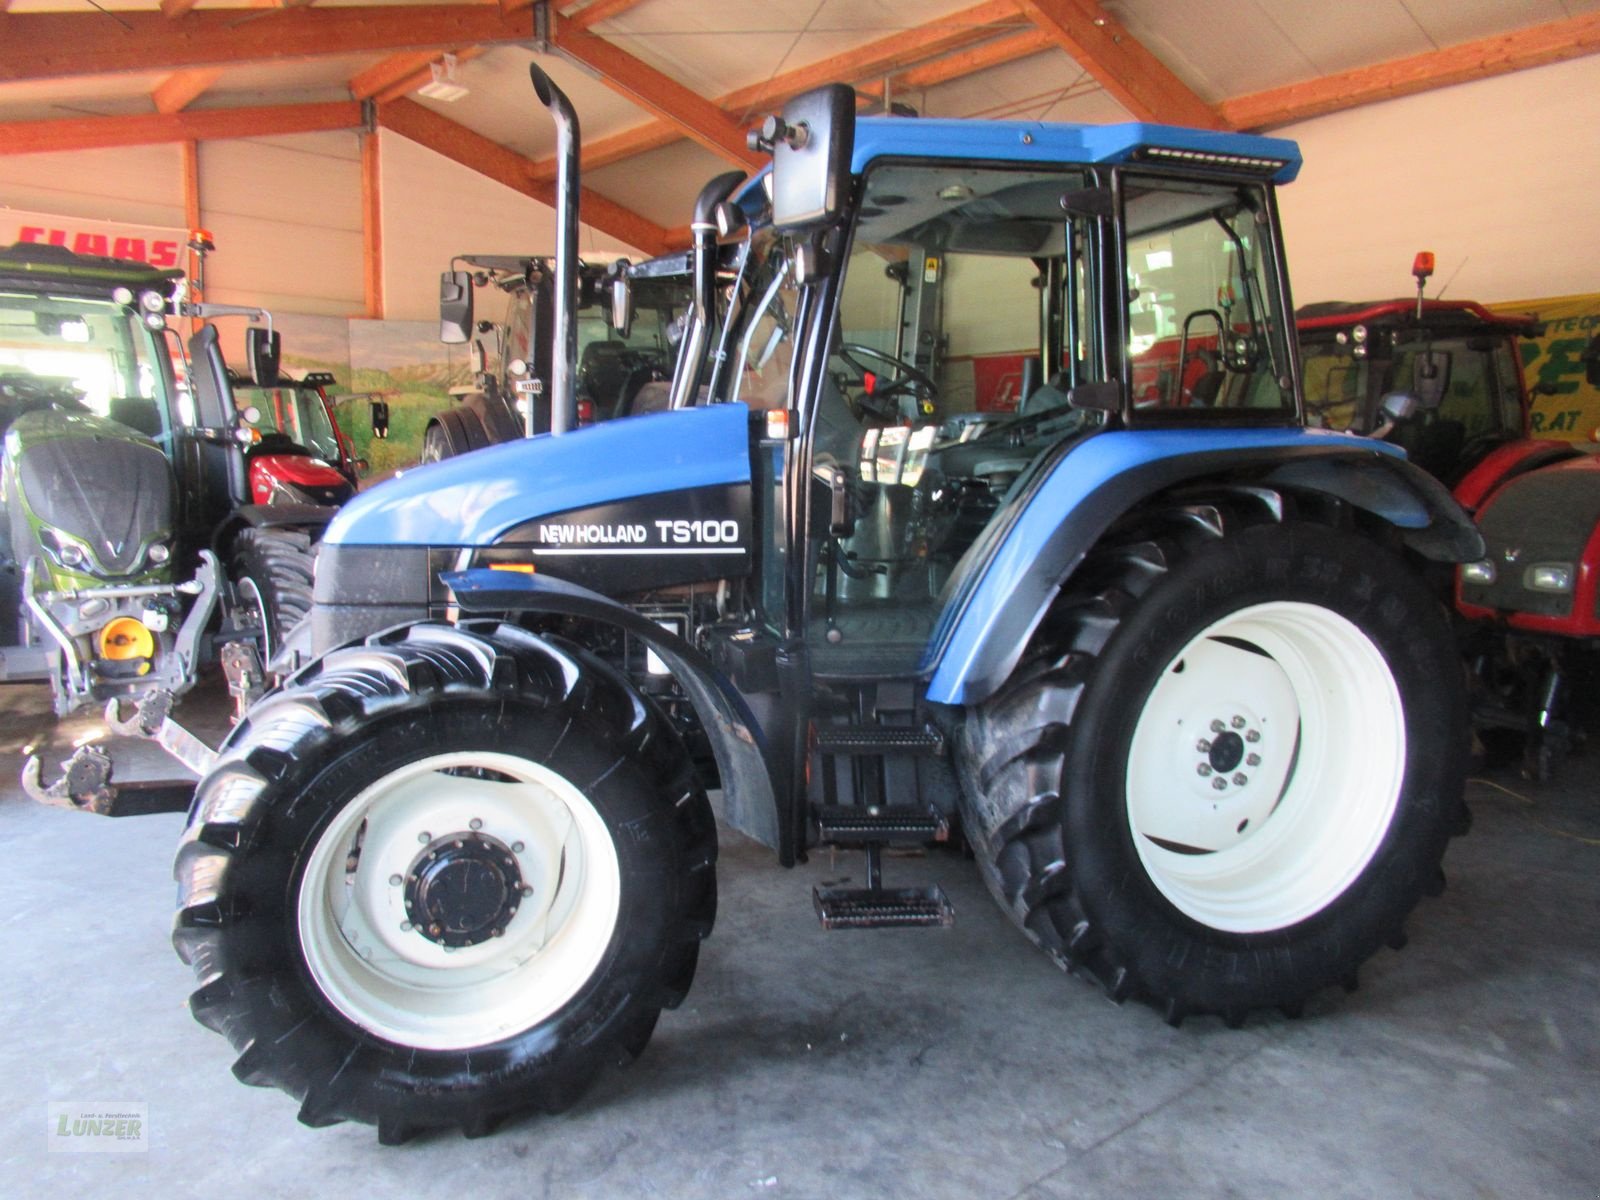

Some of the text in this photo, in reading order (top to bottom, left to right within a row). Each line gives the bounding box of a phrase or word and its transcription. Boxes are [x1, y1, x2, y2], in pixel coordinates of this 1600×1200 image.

[19, 226, 178, 267] CLAAS
[540, 519, 739, 544] NEW HOLLAND TS100
